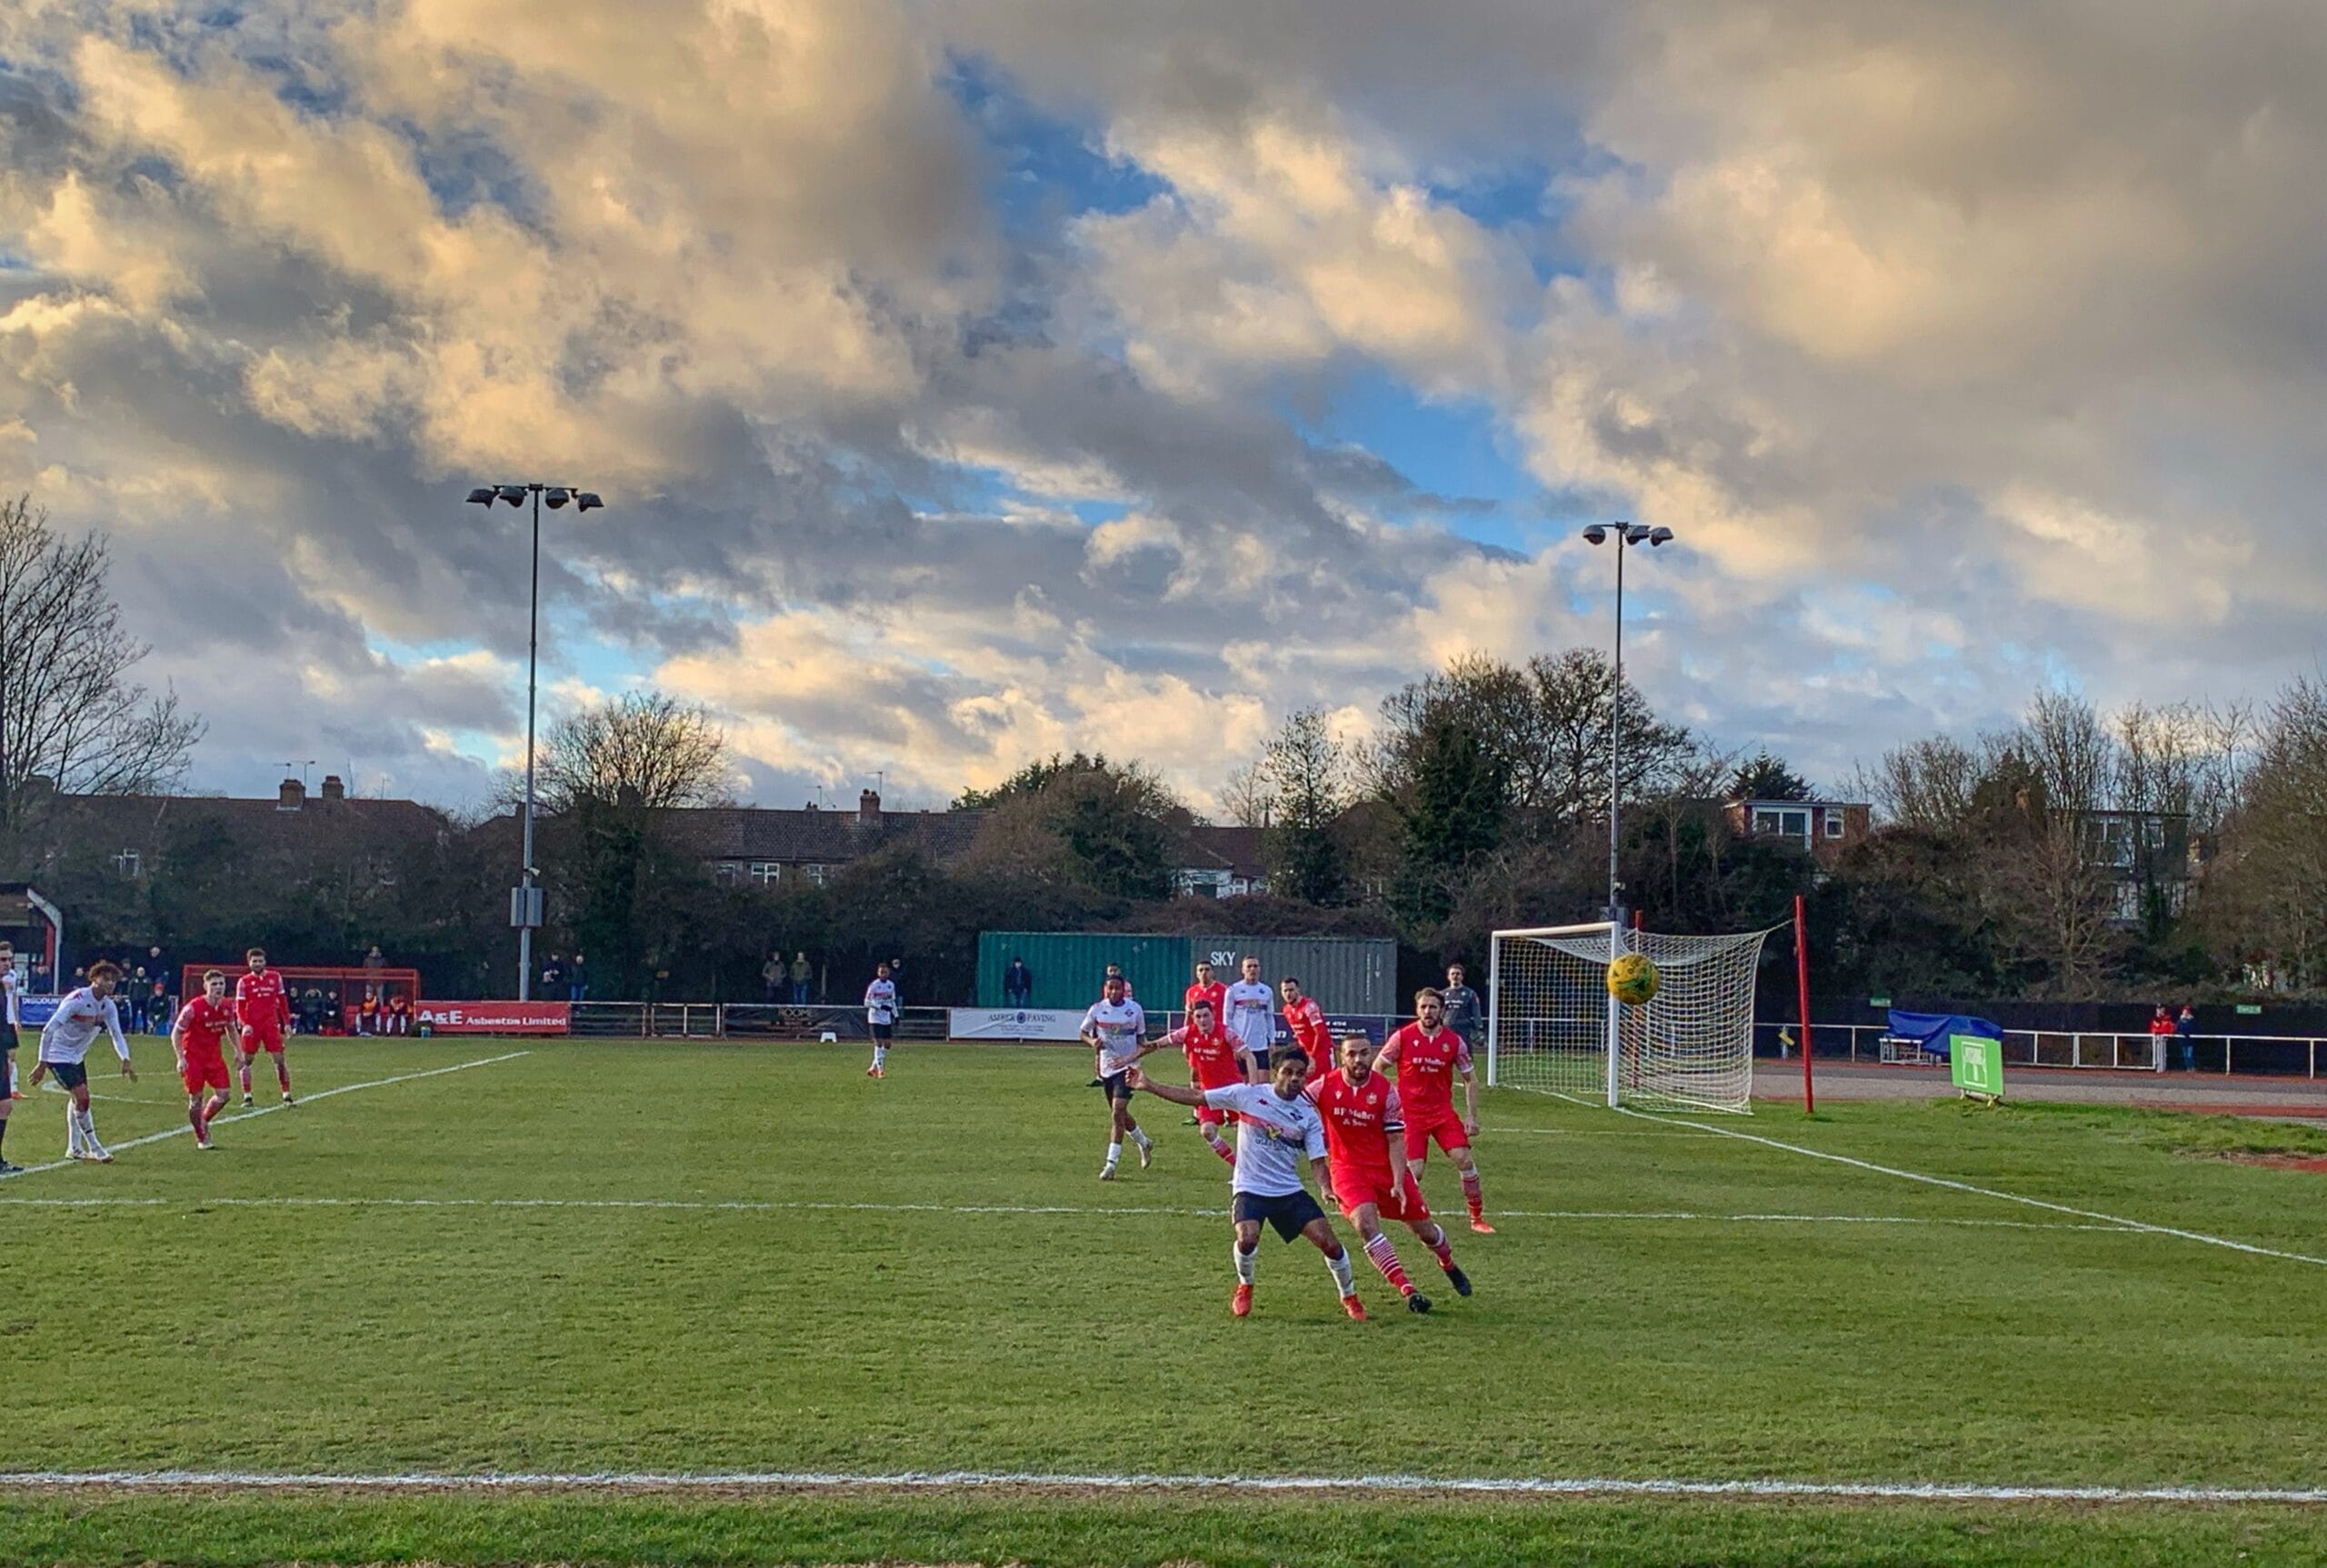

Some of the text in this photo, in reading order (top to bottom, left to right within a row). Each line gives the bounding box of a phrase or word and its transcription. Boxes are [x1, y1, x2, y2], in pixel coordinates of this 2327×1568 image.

[1210, 951, 1236, 966] SKY
[419, 1009, 566, 1025] A&E Asbestos Limited
[1027, 1013, 1056, 1023] PAVING
[1333, 1107, 1345, 1116] BF
